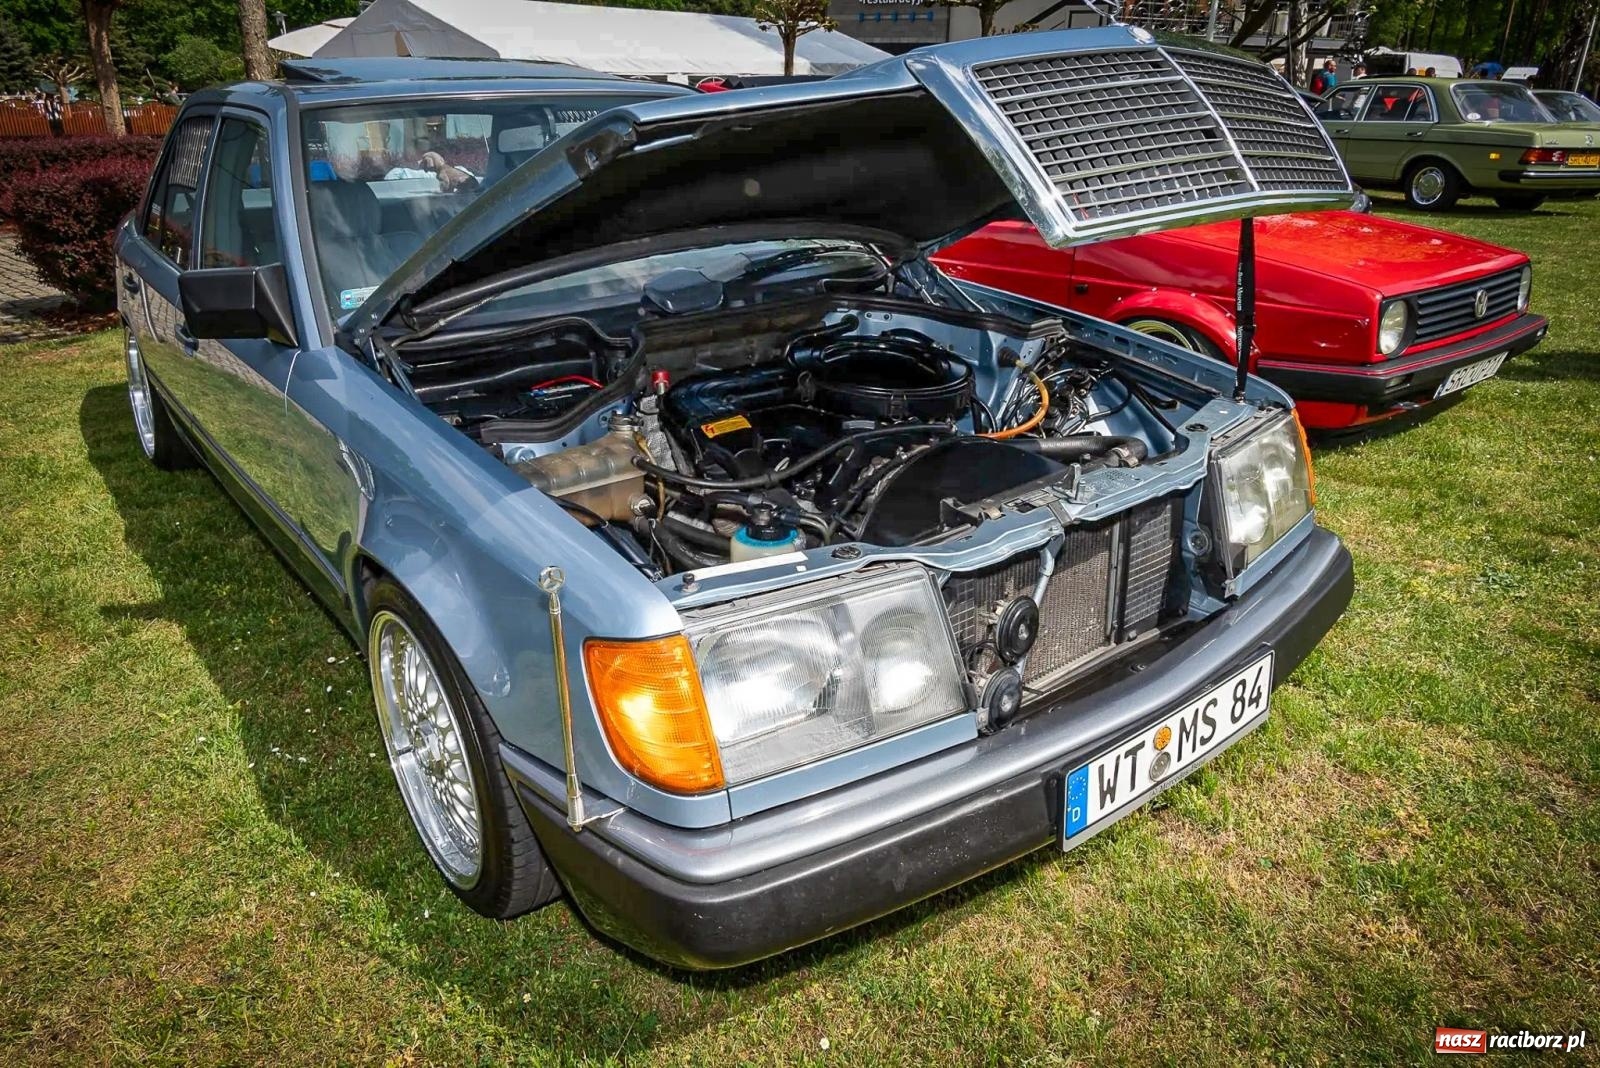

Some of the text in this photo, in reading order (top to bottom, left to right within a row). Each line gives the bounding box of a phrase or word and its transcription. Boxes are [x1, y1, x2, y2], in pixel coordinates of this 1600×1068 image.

[1098, 666, 1263, 810] WT MS 84
[1072, 806, 1081, 823] D
